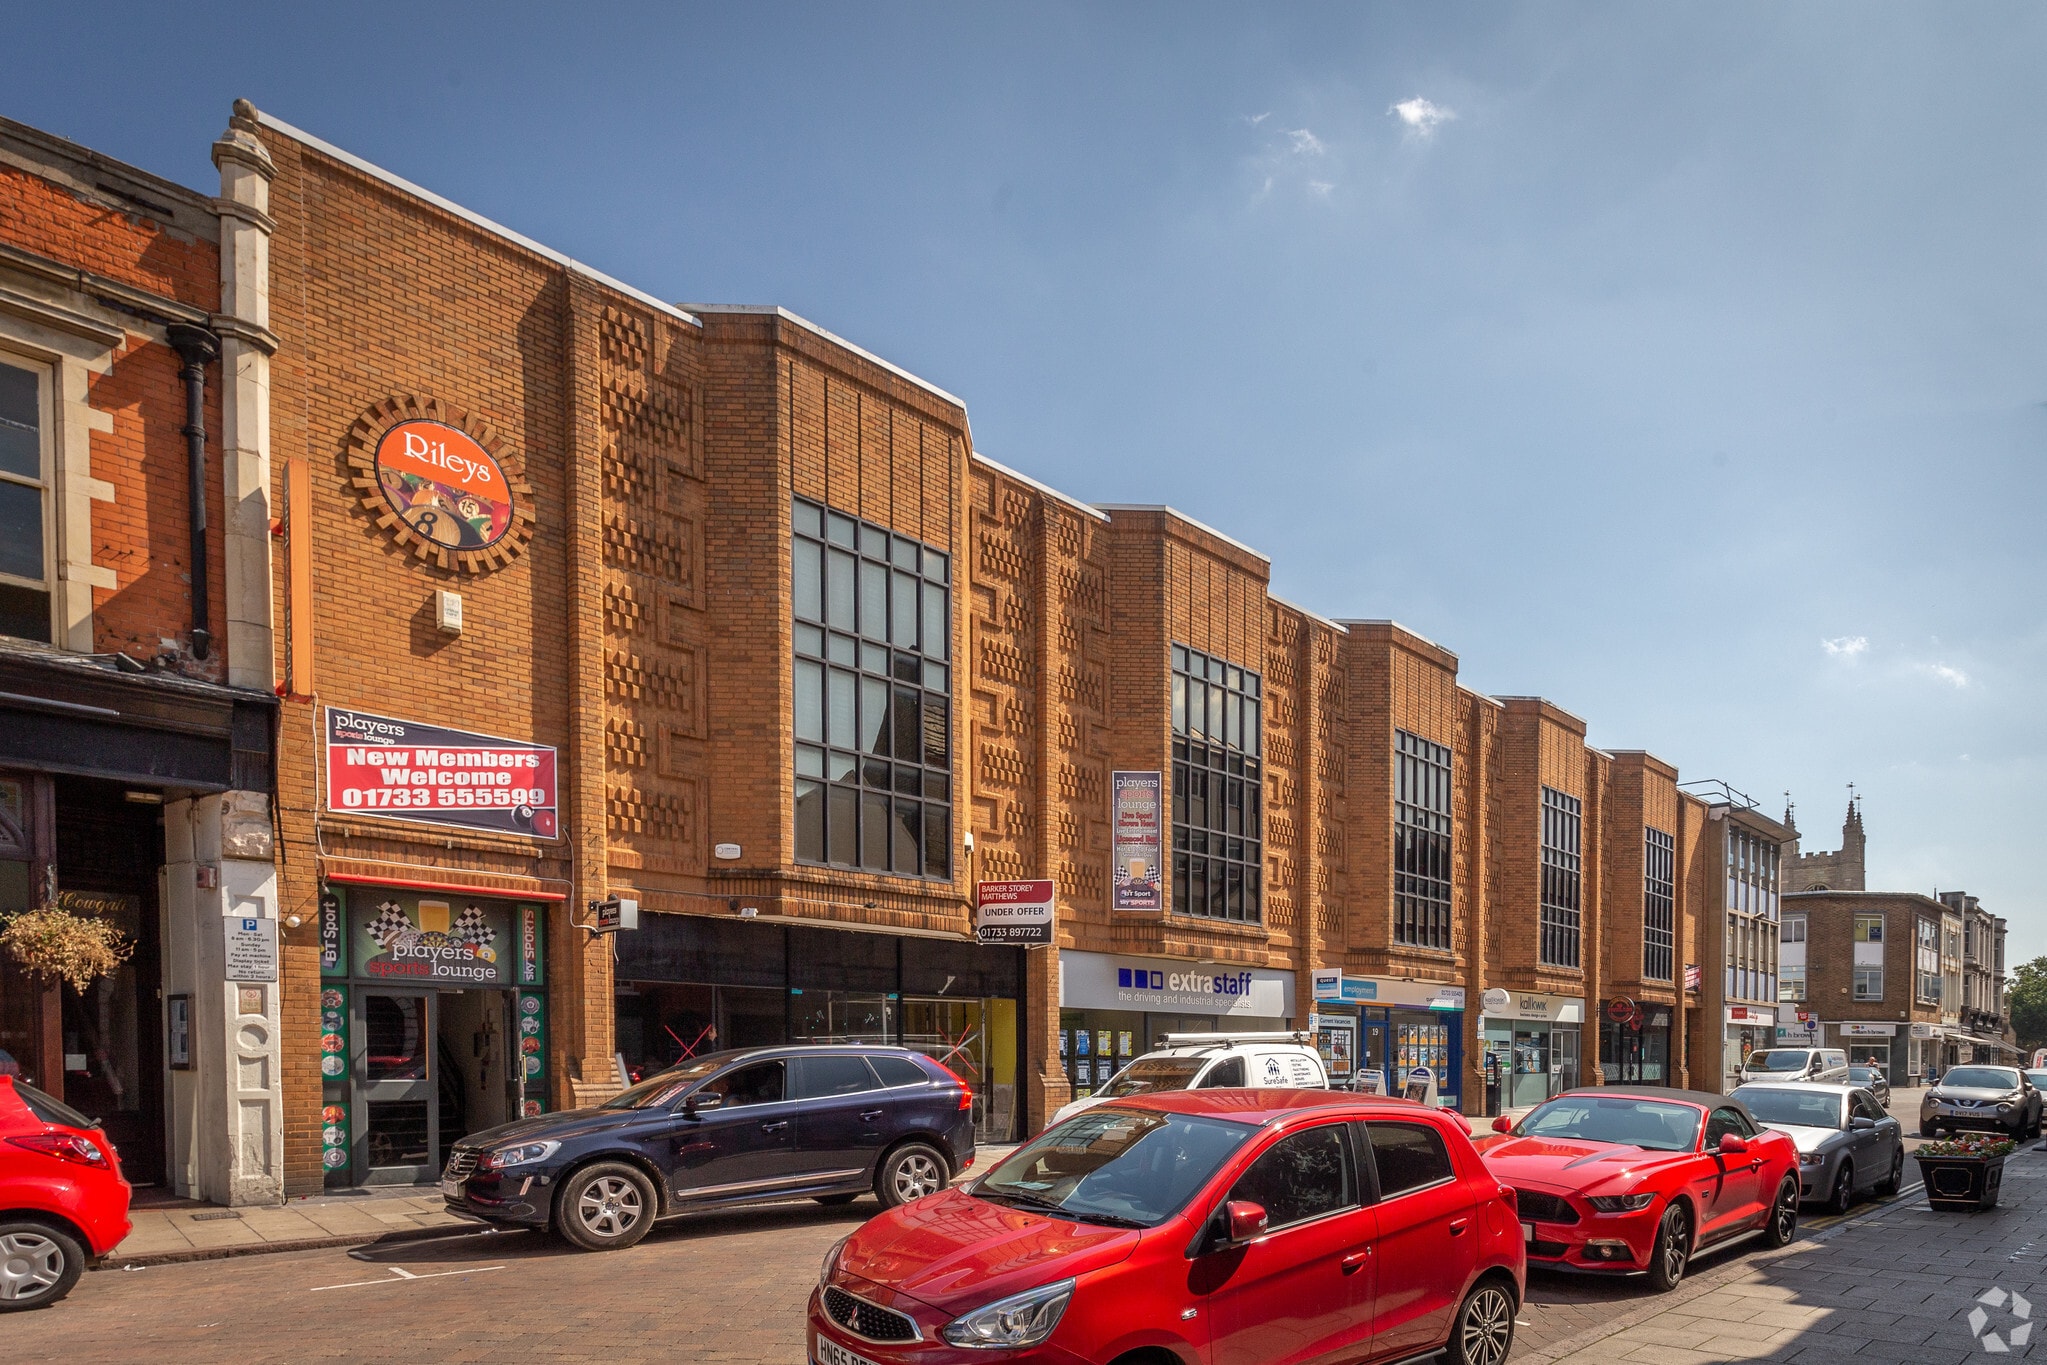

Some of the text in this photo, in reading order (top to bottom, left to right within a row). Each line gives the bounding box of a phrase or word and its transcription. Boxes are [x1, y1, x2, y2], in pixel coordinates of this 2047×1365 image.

[403, 431, 491, 483] Rileys
[335, 713, 405, 737] players
[335, 729, 395, 745] sports lounge
[346, 748, 540, 768] New Members
[381, 768, 512, 786] Welcome
[1116, 776, 1158, 790] players
[342, 788, 545, 807] 01733 555599
[1120, 789, 1155, 800] sports
[1117, 798, 1157, 810] lounge
[1121, 811, 1153, 820] Live Sport
[981, 884, 1034, 893] BARKER STOREY
[981, 892, 1018, 900] MATTHEWS
[1134, 890, 1151, 898] Sport
[985, 907, 1044, 917] UNDER OFFER
[246, 920, 255, 930] P
[322, 901, 339, 962] BT Sport
[980, 928, 1042, 937] 01733 897722
[391, 940, 474, 962] players
[523, 909, 536, 981] sky SPORTS
[369, 961, 497, 981] sports lounge
[1168, 969, 1252, 996] extrastaff
[1343, 985, 1375, 995] employment
[1118, 990, 1132, 1001] the
[1134, 992, 1161, 1005] driving
[1162, 994, 1178, 1004] and
[1179, 994, 1213, 1006] industrial
[1372, 1028, 1379, 1037] 19
[1263, 1075, 1289, 1085] SureSafe
[820, 1338, 848, 1365] HN65
